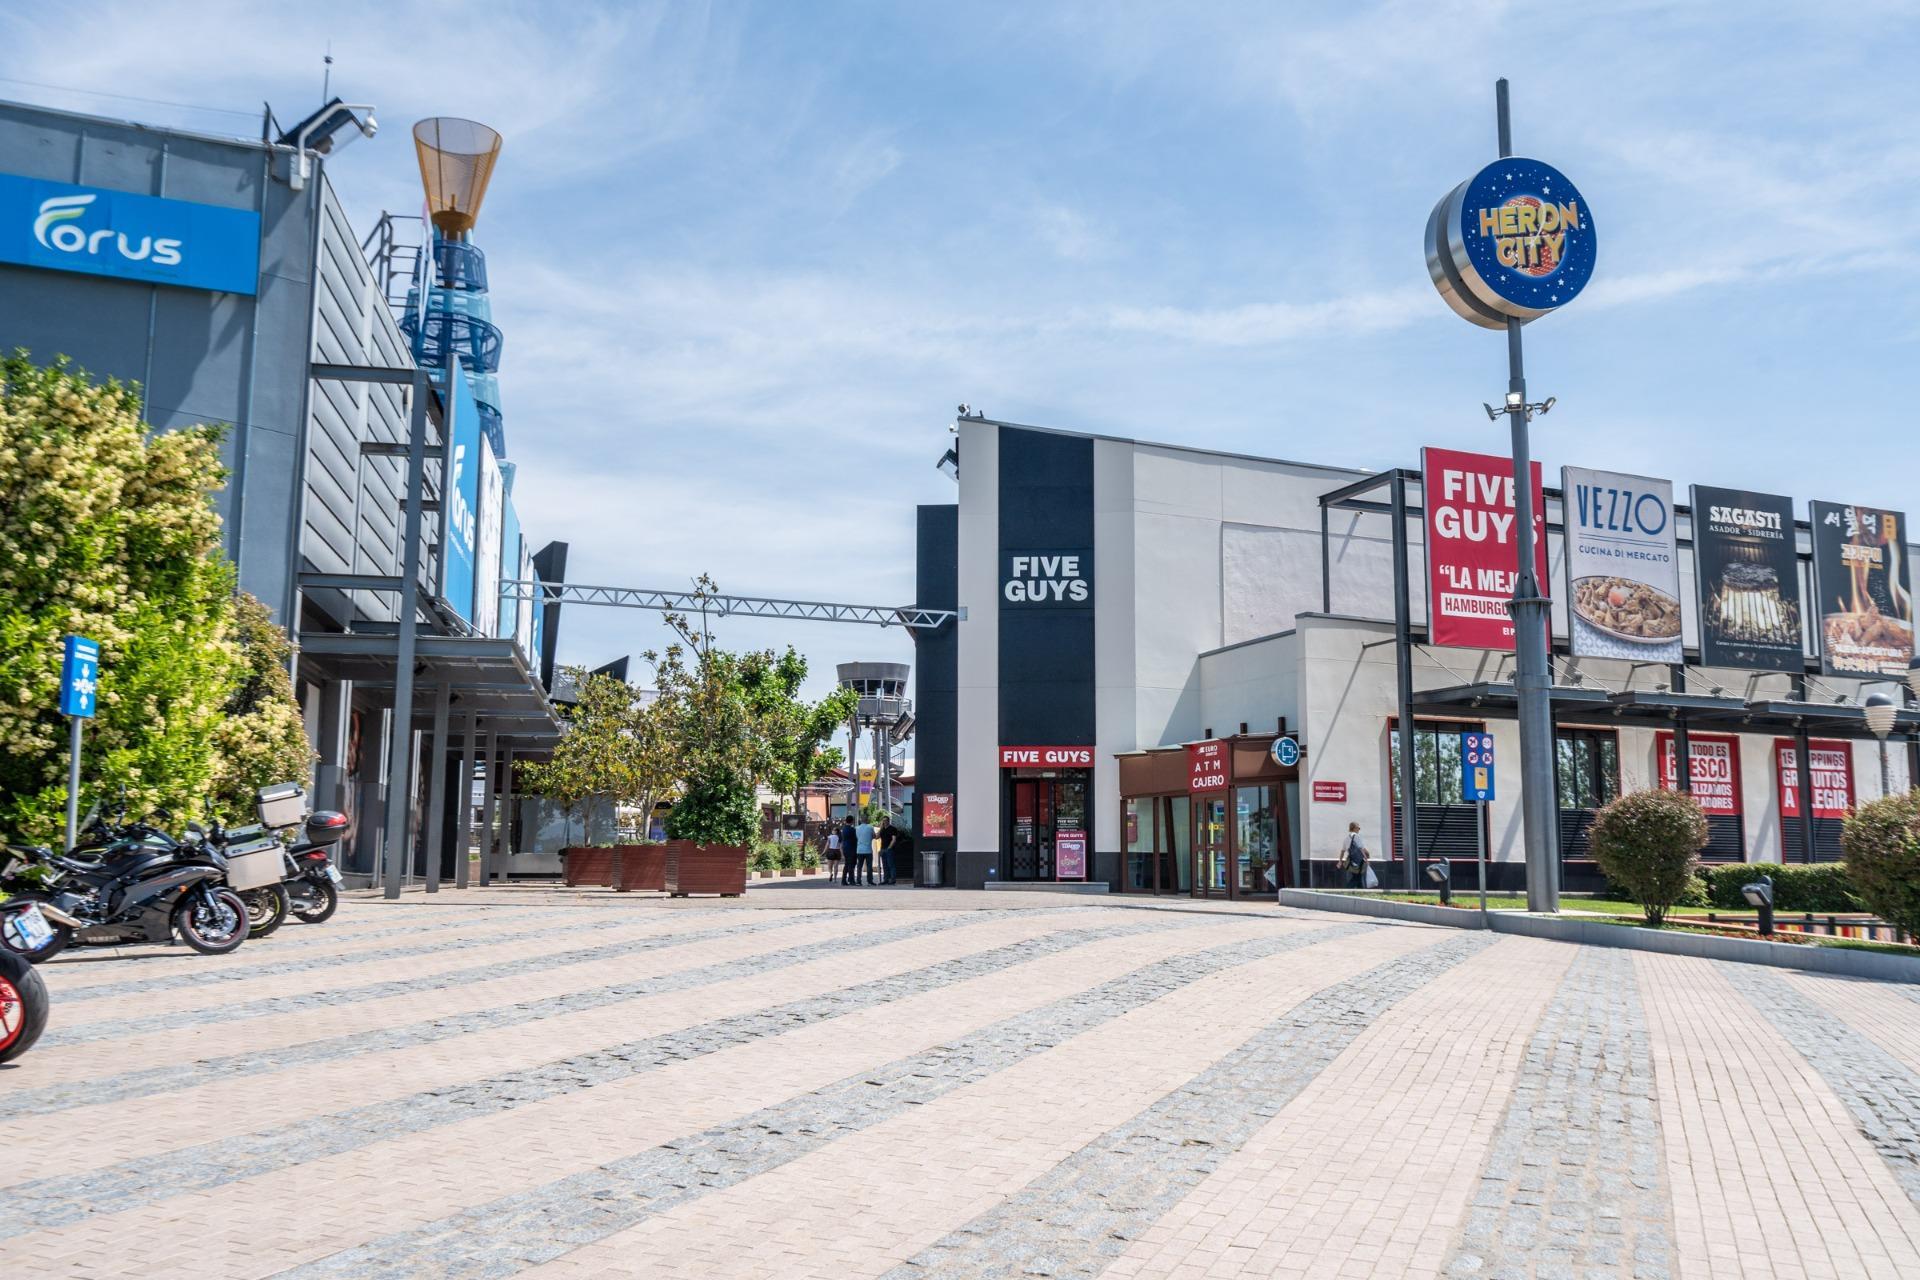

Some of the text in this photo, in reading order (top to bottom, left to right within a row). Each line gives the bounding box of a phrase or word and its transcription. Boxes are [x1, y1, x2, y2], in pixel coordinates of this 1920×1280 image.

[1479, 201, 1580, 237] HERON
[1496, 233, 1566, 268] CITY
[1443, 469, 1516, 508] FIVE
[1577, 484, 1667, 535] VEZZO
[1709, 524, 1784, 540] ASADOR SIDRERÍA
[1578, 545, 1670, 563] CUCINA DI MERCATO
[1012, 556, 1080, 577] FIVE
[1004, 579, 1089, 602] GUYS
[1003, 751, 1090, 763] FIVE GUYS
[1692, 744, 1727, 757] TODO ES
[1782, 751, 1845, 767] 15 PPINGS
[1670, 756, 1728, 778] FESCO
[1192, 774, 1225, 789] CAJERO
[1782, 769, 1848, 789] GRTUITOS
[1784, 787, 1796, 808] A
